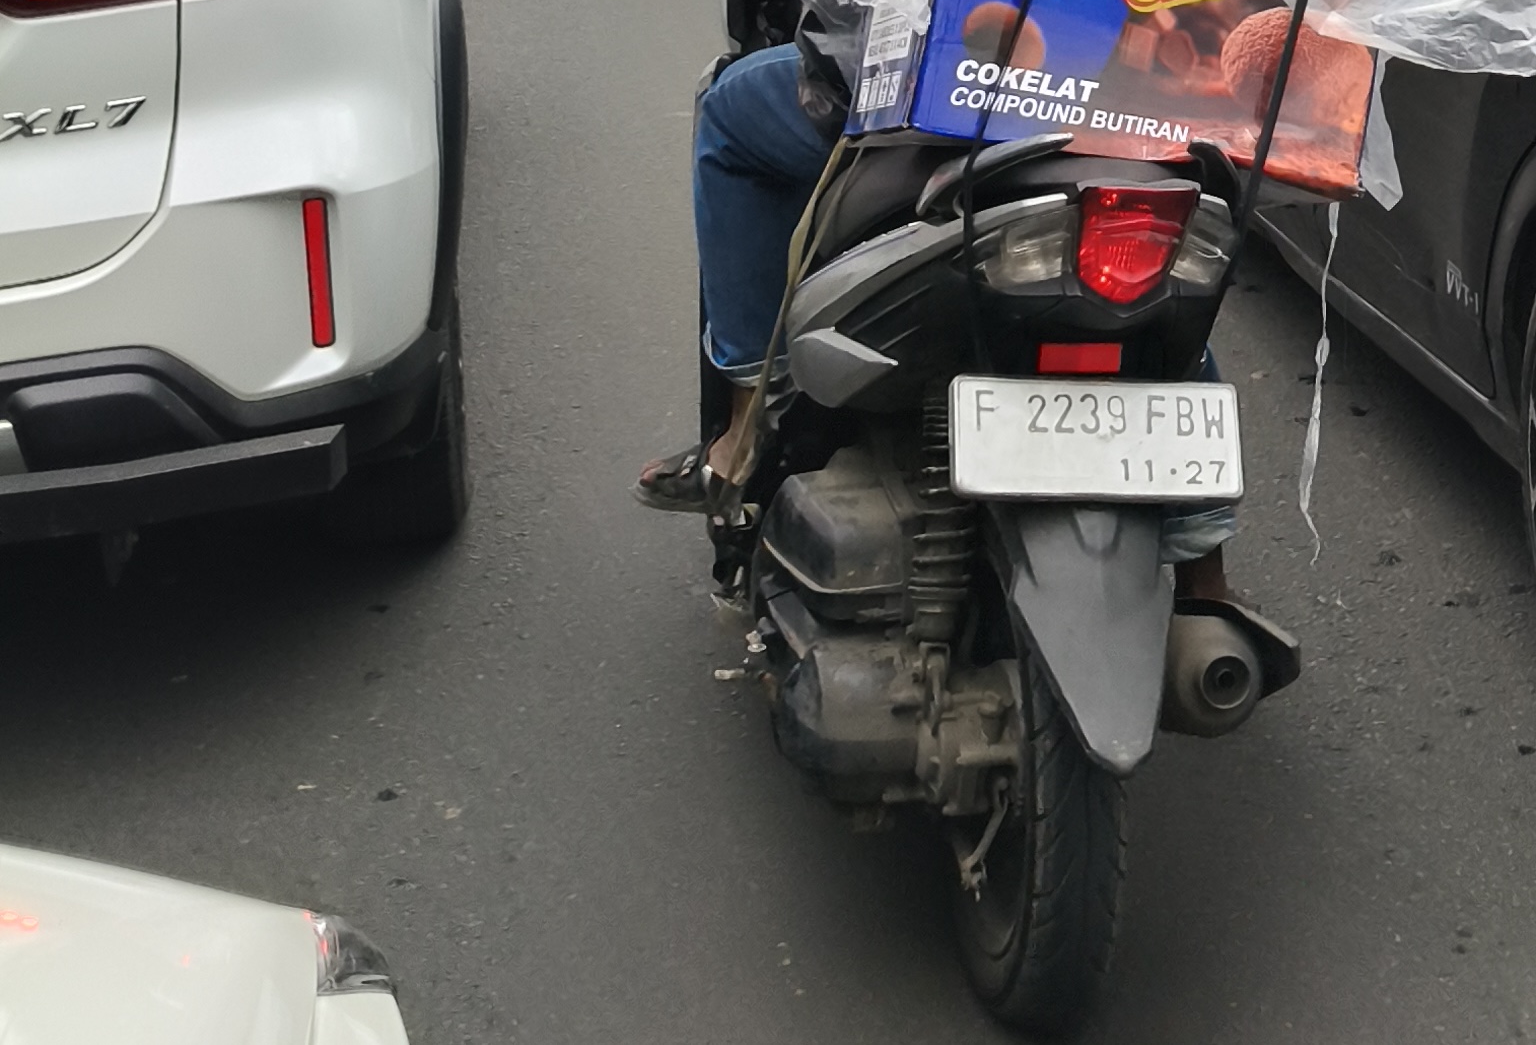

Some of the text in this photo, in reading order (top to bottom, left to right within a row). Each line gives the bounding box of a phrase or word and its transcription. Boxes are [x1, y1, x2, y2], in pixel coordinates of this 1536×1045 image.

[956, 59, 1100, 104] COKELAT
[0, 95, 147, 143] XL7
[950, 86, 1190, 143] COMPOUND BUTIRAN
[975, 389, 1225, 440] F 2239 FBW
